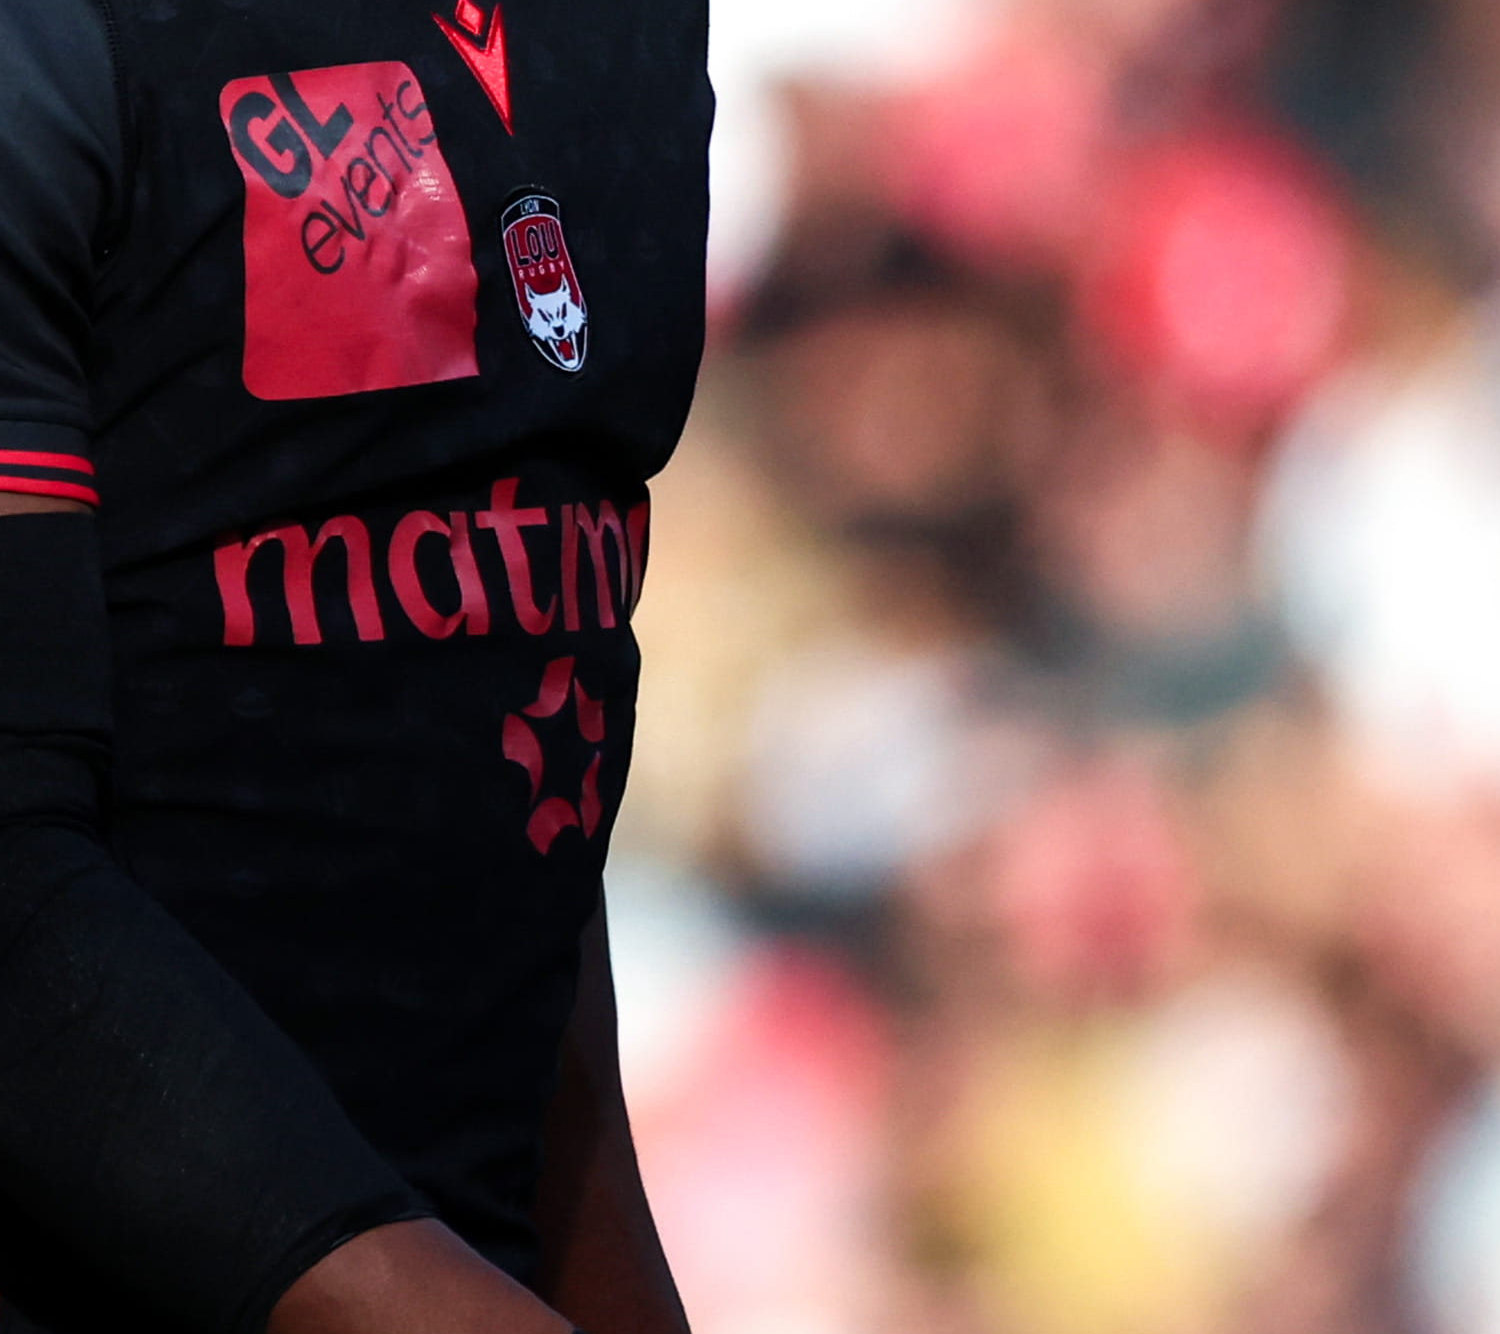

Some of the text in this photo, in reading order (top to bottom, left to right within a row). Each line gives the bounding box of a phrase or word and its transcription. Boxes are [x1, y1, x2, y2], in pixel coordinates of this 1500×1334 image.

[229, 70, 354, 199] GL
[301, 80, 437, 275] events
[510, 220, 559, 267] LOU
[213, 476, 649, 647] matm
